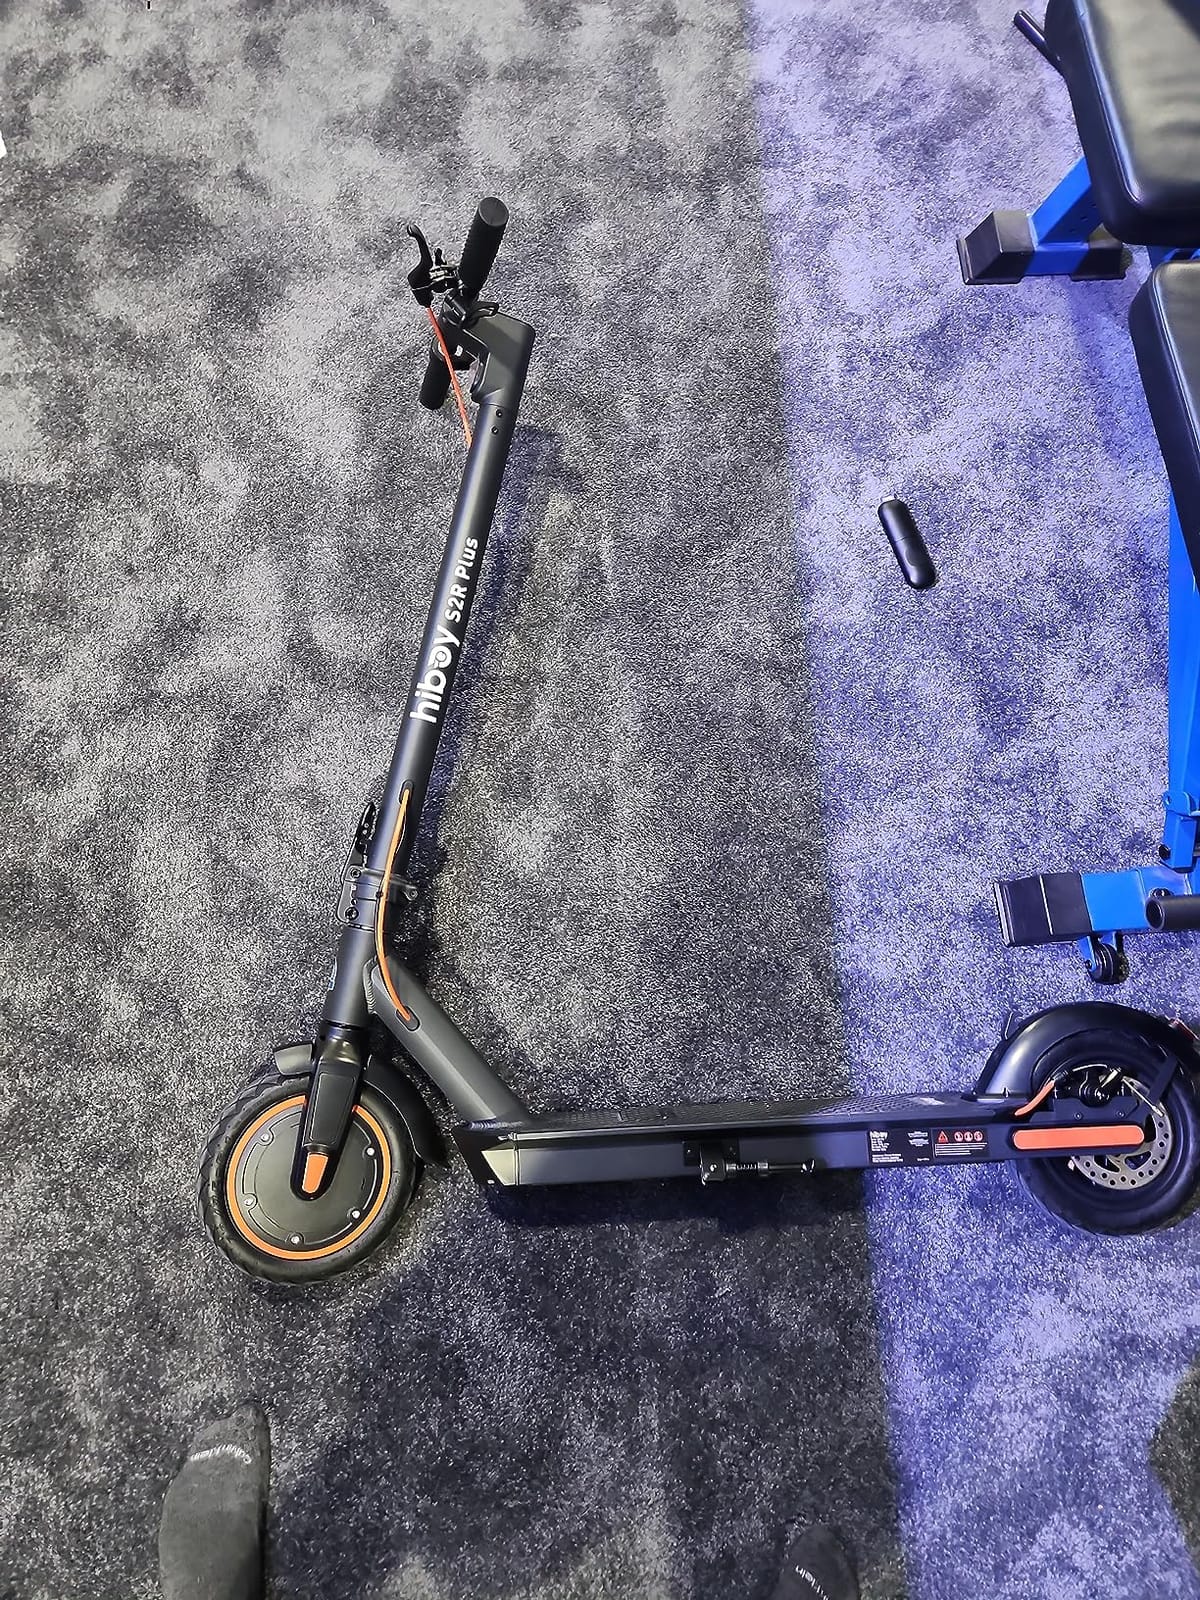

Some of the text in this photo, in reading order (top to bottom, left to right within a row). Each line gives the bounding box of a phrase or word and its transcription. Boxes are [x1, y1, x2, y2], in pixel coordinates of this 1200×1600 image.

[410, 537, 479, 723] hiboy S2R Plus
